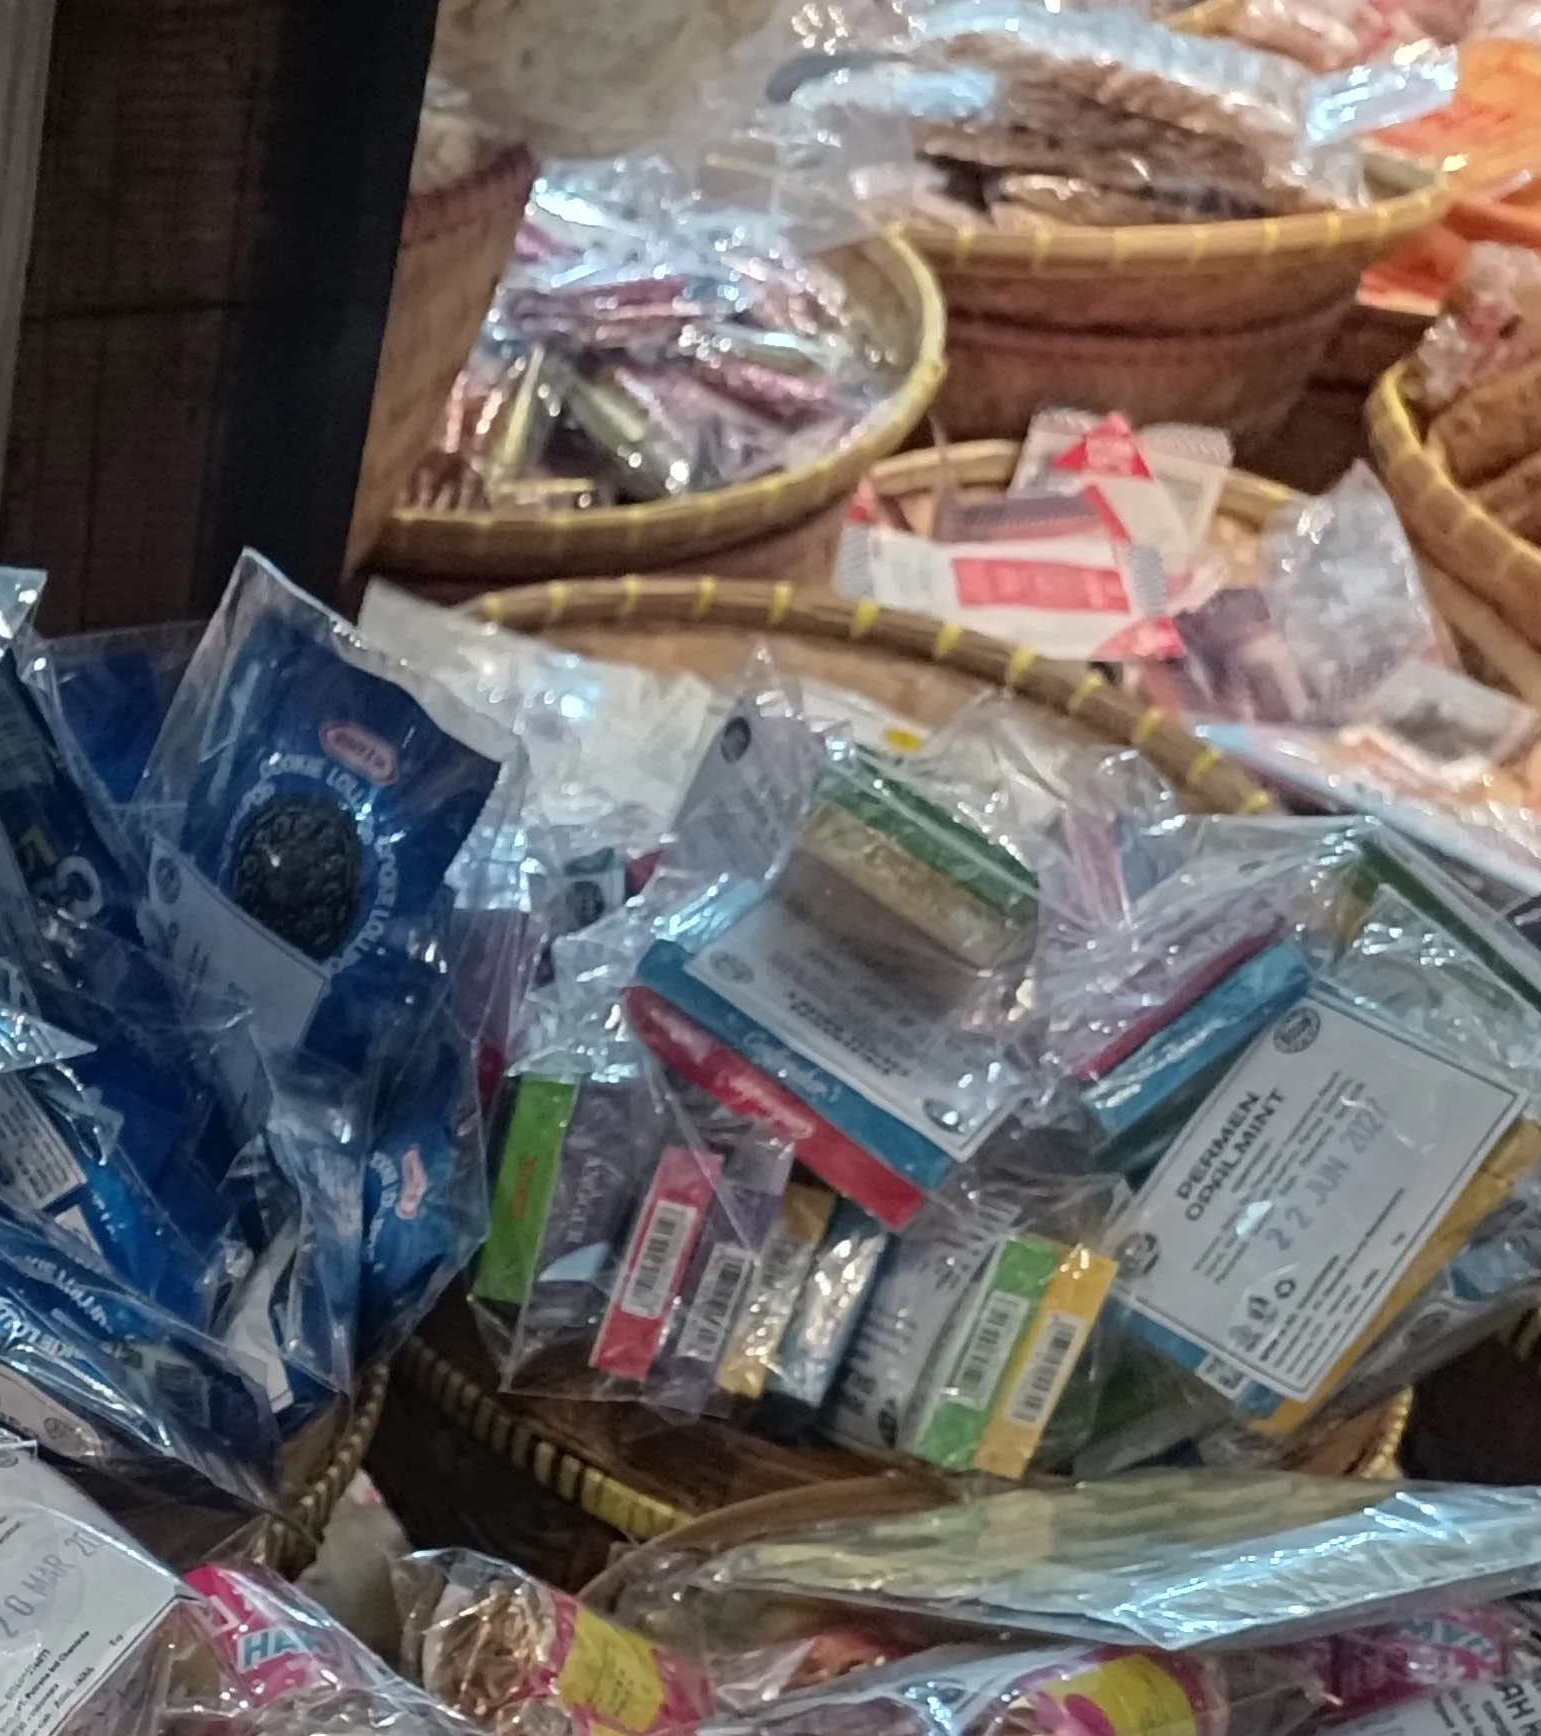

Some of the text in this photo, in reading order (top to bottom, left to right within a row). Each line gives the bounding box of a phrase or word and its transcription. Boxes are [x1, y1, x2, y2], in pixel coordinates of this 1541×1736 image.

[1173, 1085, 1262, 1202] PERMEN
[1183, 1084, 1287, 1225] OPALMINT
[1300, 1150, 1352, 1210] JUN
[18, 1545, 79, 1604] MAR
